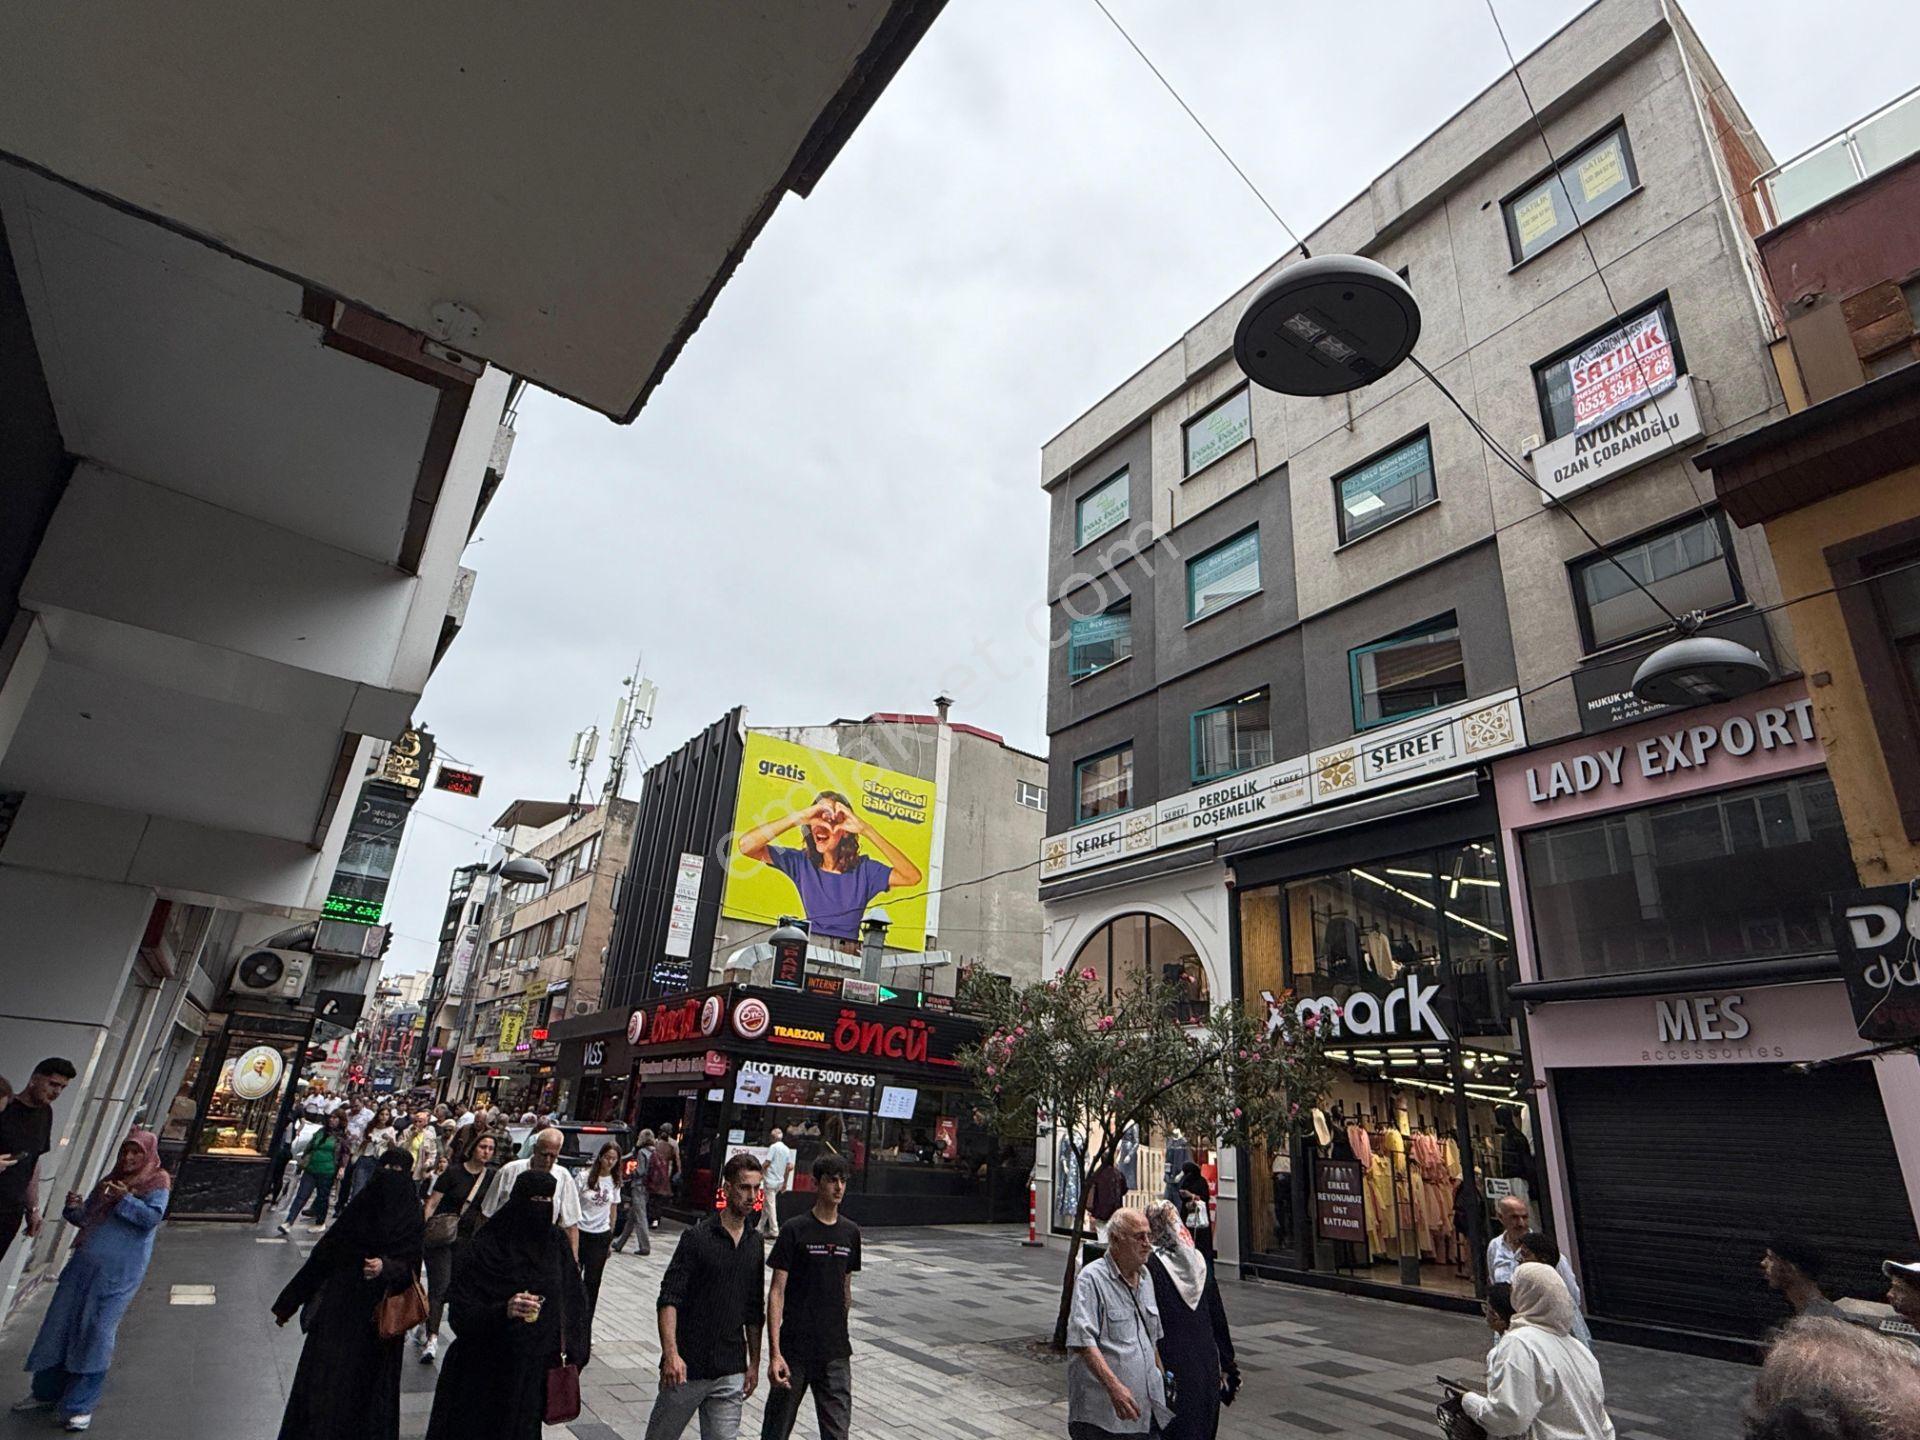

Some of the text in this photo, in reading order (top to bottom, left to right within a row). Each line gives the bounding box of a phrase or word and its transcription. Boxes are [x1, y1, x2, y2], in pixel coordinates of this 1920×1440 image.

[1574, 325, 1663, 389] SATILIK
[1575, 404, 1647, 456] AVUKAT
[1554, 412, 1681, 483] OZAN ÇOBANOĞLU
[1588, 690, 1634, 710] HUKUK ve
[1371, 731, 1444, 772] ŞEREF
[1526, 697, 1816, 803] LADY EXPORT
[758, 759, 806, 781] gratis
[862, 794, 926, 823] Bakıyoruz
[863, 780, 928, 809] Size Güzel
[1198, 779, 1258, 809] PERDELİK
[1075, 831, 1118, 859] ŞEREF
[807, 976, 842, 992] INTERNET
[773, 1025, 825, 1042] TRABZON
[1655, 996, 1749, 1042] MES
[1641, 1045, 1785, 1062] accessories
[742, 1060, 771, 1075] ALO
[774, 1063, 816, 1080] PAKET
[818, 1069, 842, 1084] 500
[843, 1072, 859, 1086] 65
[860, 1074, 876, 1087] 65
[1327, 1181, 1350, 1191] ERKEK
